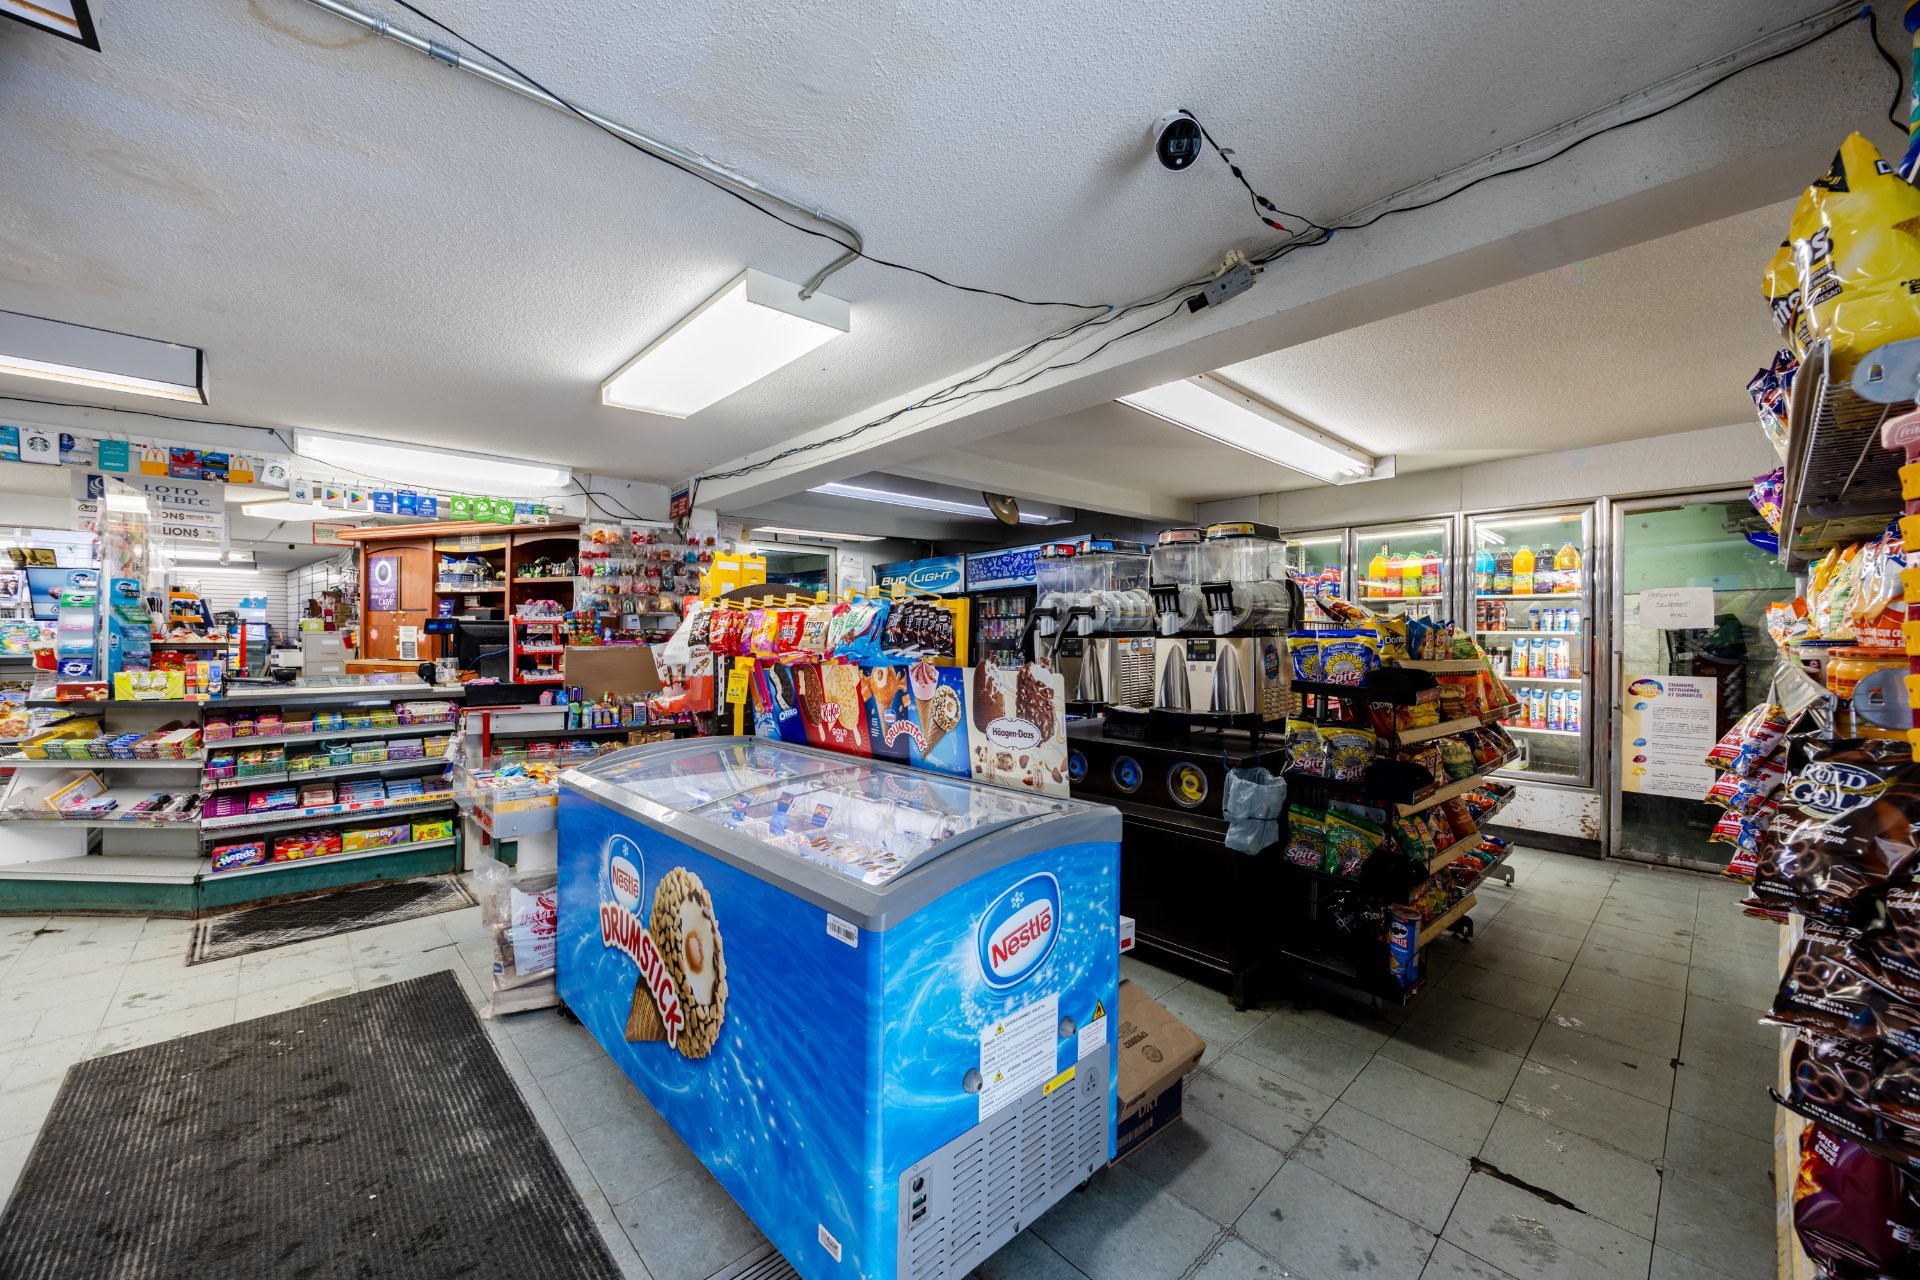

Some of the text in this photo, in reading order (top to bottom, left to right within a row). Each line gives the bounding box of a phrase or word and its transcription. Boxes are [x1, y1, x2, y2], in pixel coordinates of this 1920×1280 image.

[144, 484, 198, 496] LOTO
[148, 492, 211, 507] UÉBEC
[881, 570, 954, 587] BUD LIGHT
[1327, 669, 1362, 684] Spitz
[778, 708, 798, 721] OREO
[832, 728, 848, 736] GOLD
[836, 735, 844, 743] OR
[885, 720, 928, 752] DRUMSTICK
[365, 828, 394, 842] Fun Dip
[219, 849, 256, 866] Nerds
[612, 865, 640, 901] Nestlé
[991, 906, 1052, 969] Nestlé
[600, 900, 685, 1049] DRUMSTICK
[1817, 1131, 1840, 1151] SPICY
